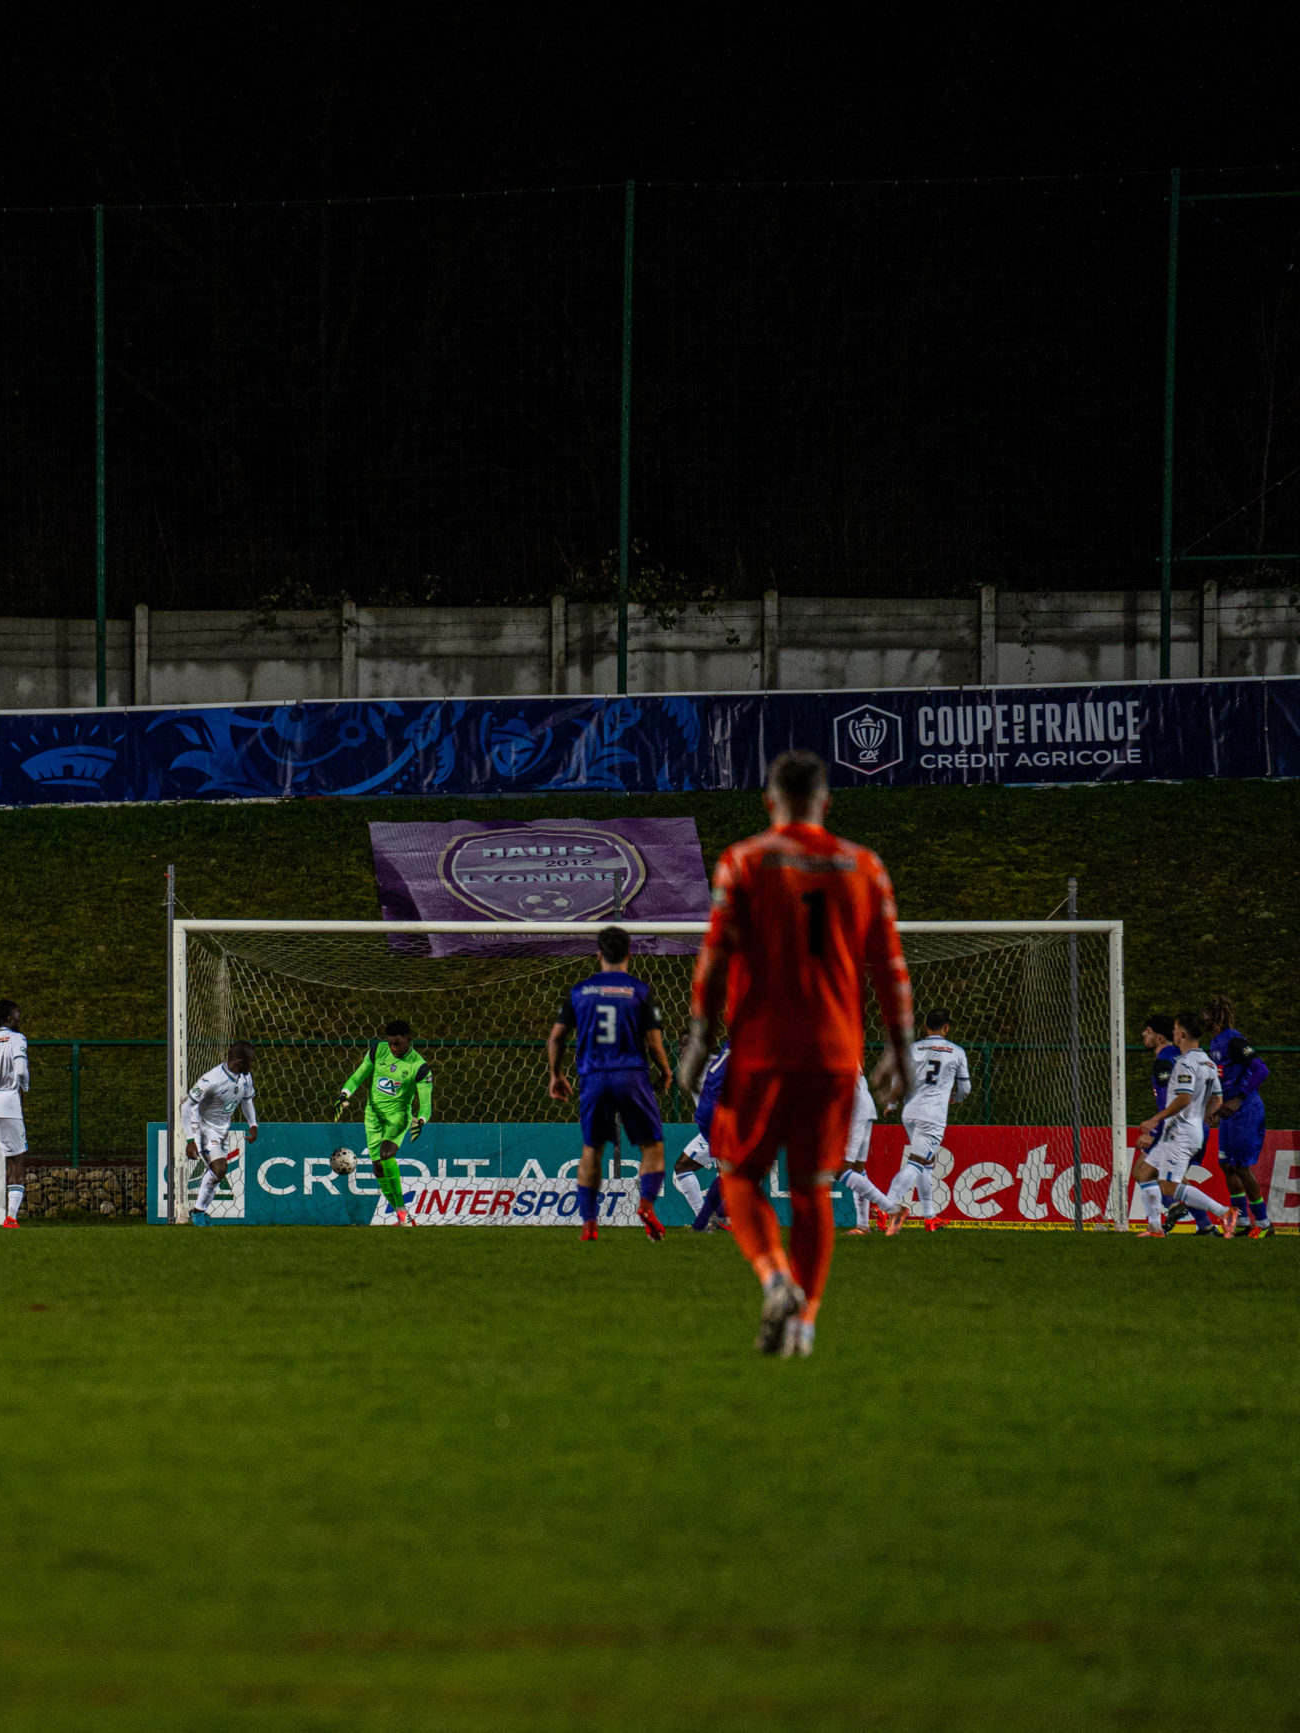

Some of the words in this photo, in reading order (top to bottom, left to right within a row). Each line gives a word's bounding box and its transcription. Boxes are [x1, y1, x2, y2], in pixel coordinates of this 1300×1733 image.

[918, 703, 1010, 747] COUPE
[1029, 700, 1141, 745] FRANCE
[919, 750, 1010, 769] CRÉDIT
[1014, 748, 1143, 768] AGRICOLE
[545, 859, 593, 868] 2012
[595, 1004, 618, 1044] 3
[925, 1060, 941, 1084] 2
[415, 1190, 626, 1216] INTERSPOT
